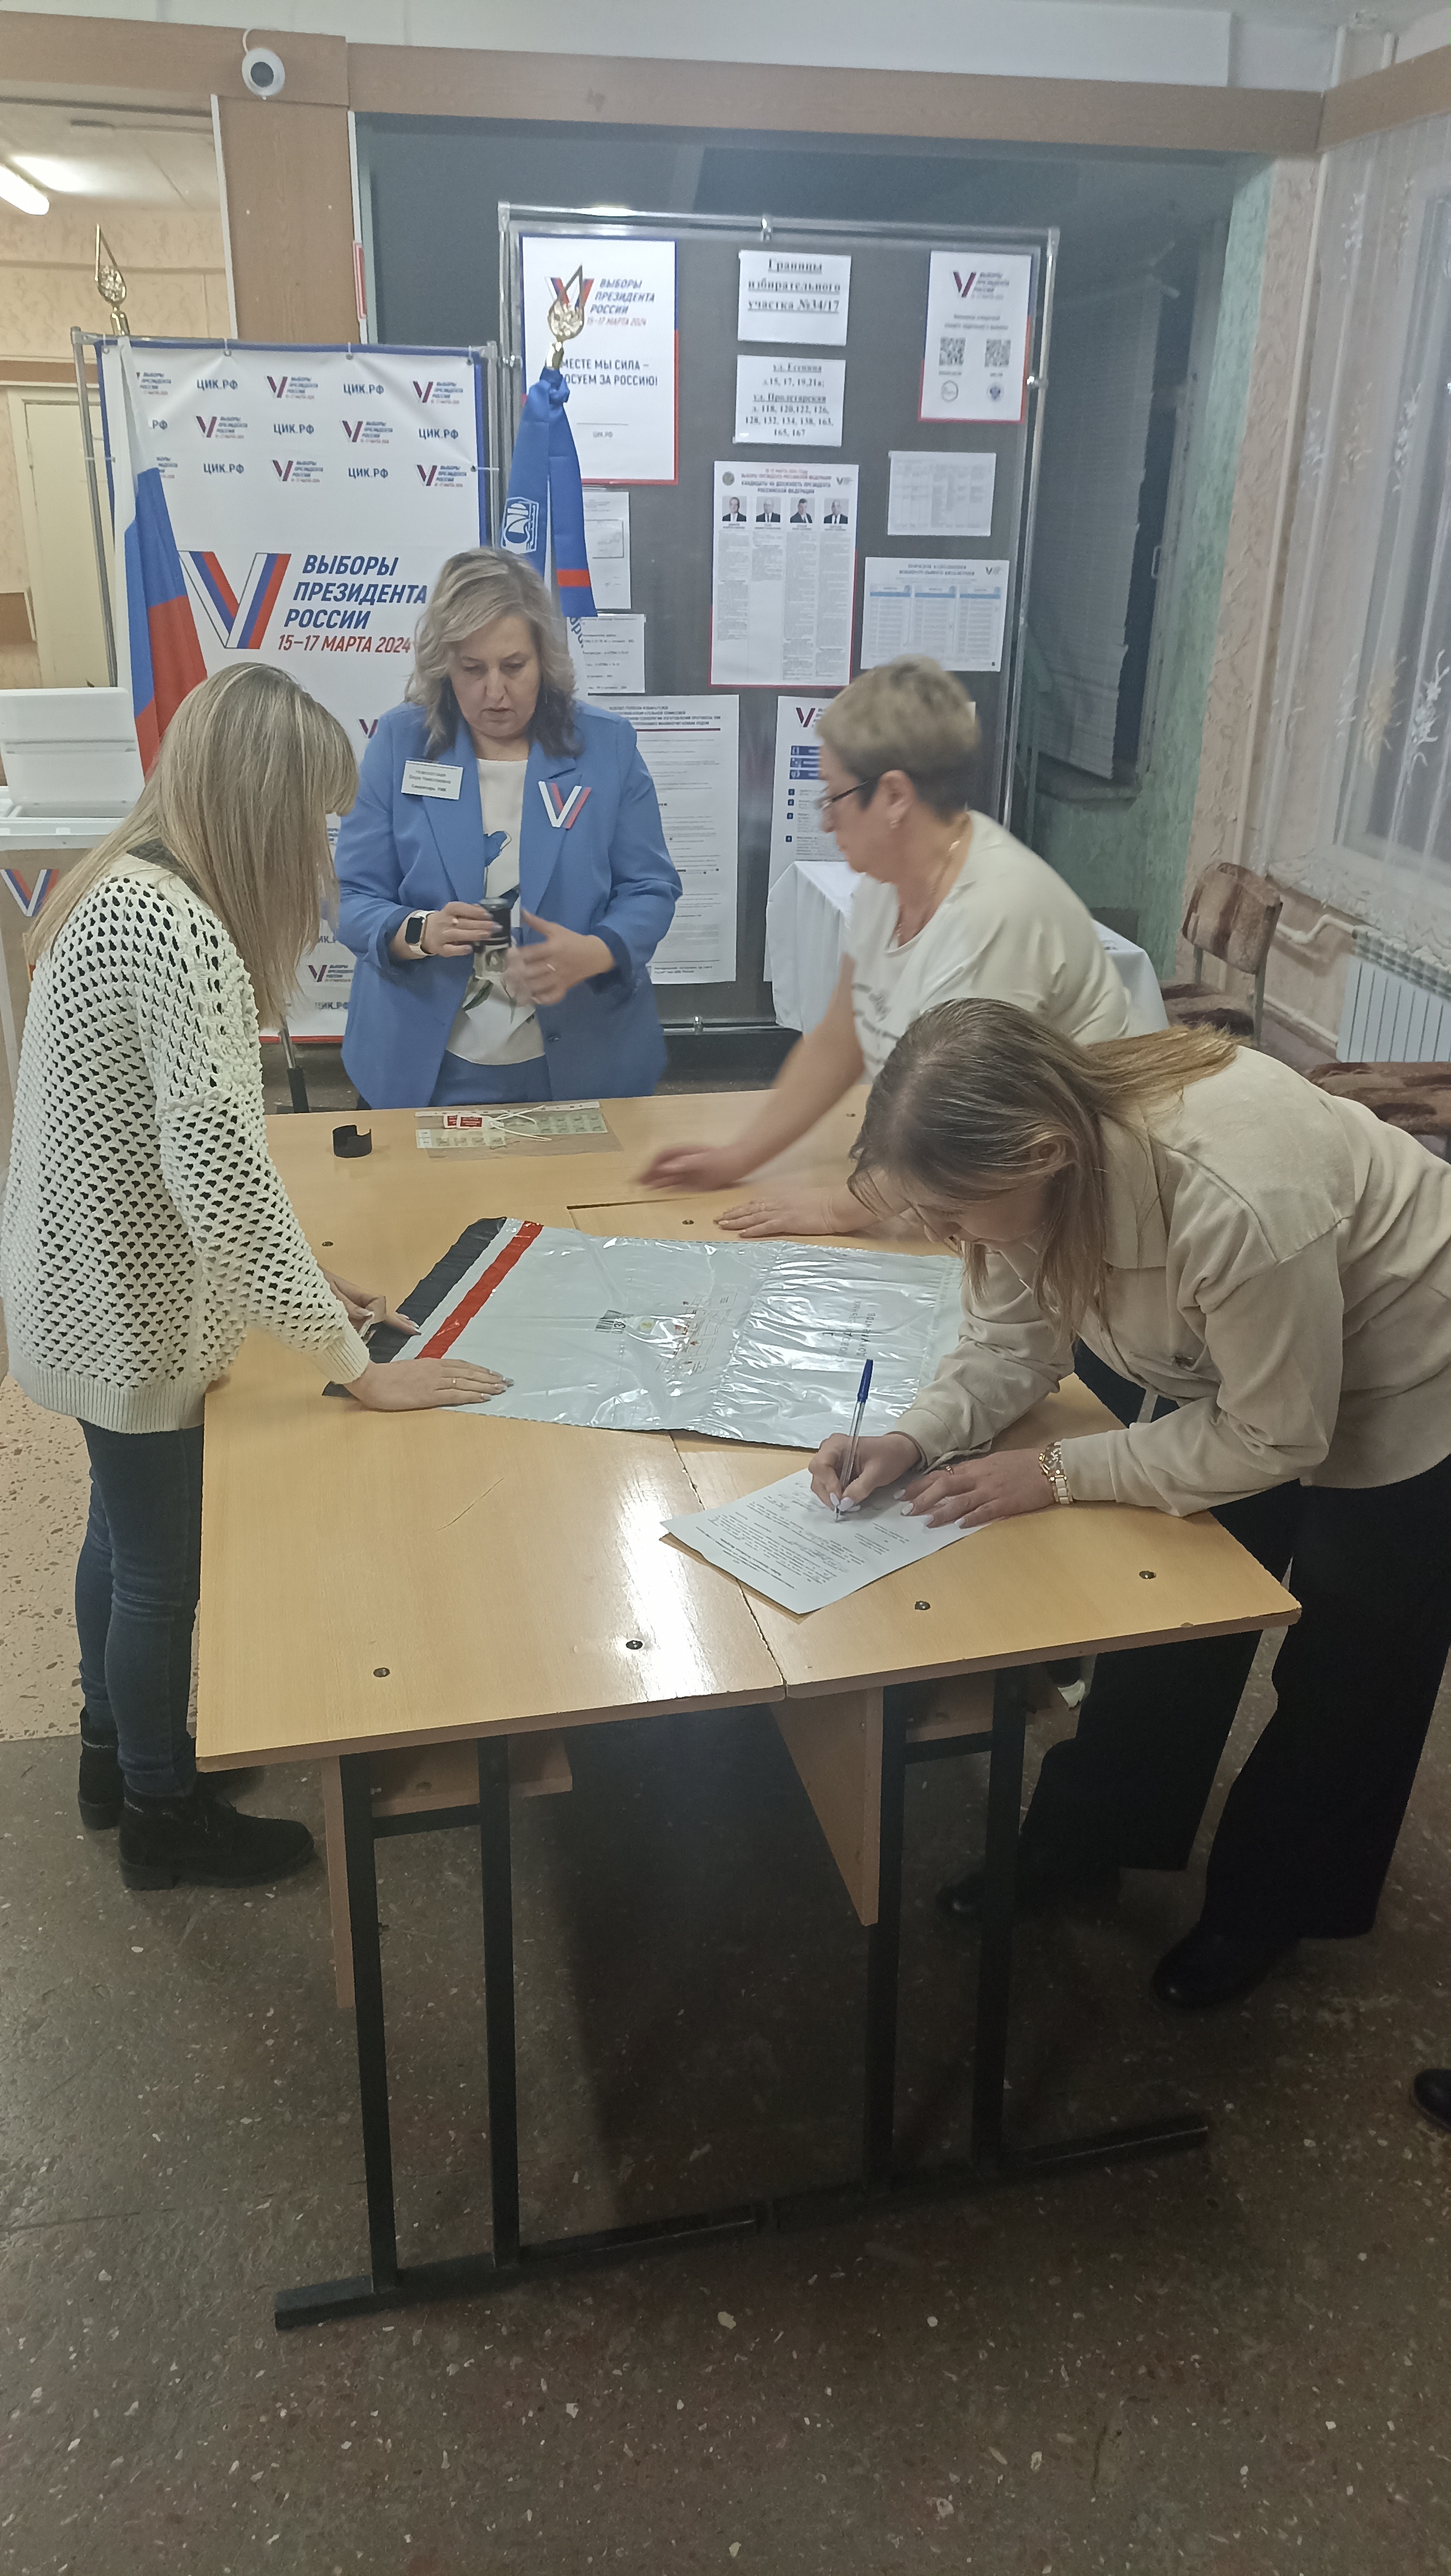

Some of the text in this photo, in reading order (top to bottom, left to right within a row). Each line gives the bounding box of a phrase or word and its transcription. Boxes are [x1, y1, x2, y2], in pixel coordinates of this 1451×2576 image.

[767, 258, 822, 274] Границы
[600, 278, 643, 289] ВЫБОРЫ
[748, 278, 841, 294] избирательного
[595, 291, 655, 303] ПРЕЗИДЕНТА
[590, 304, 629, 314] РОССИИ
[748, 298, 840, 314] участка №34/17
[560, 358, 592, 369] МЕСТЕ
[595, 359, 612, 370] МЫ
[615, 359, 640, 370] СИЛА
[197, 379, 238, 391] ЦИК.РФ
[599, 374, 611, 386] ЗА
[614, 374, 658, 386] РОССИЮ!
[343, 383, 384, 395] ЦИК.РФ
[273, 423, 315, 435] ЦИК.РФ
[418, 428, 459, 440] ЦИК.РФ
[203, 462, 245, 475] ЦИК.РФ
[348, 467, 388, 480] ЦИК.РФ
[302, 554, 399, 576] ВЫБОРЫ
[293, 582, 427, 606] ПРЕЗИДЕНТА
[284, 608, 371, 629] РОССИИ
[321, 636, 372, 652] МАРТА
[374, 637, 411, 653] 2024
